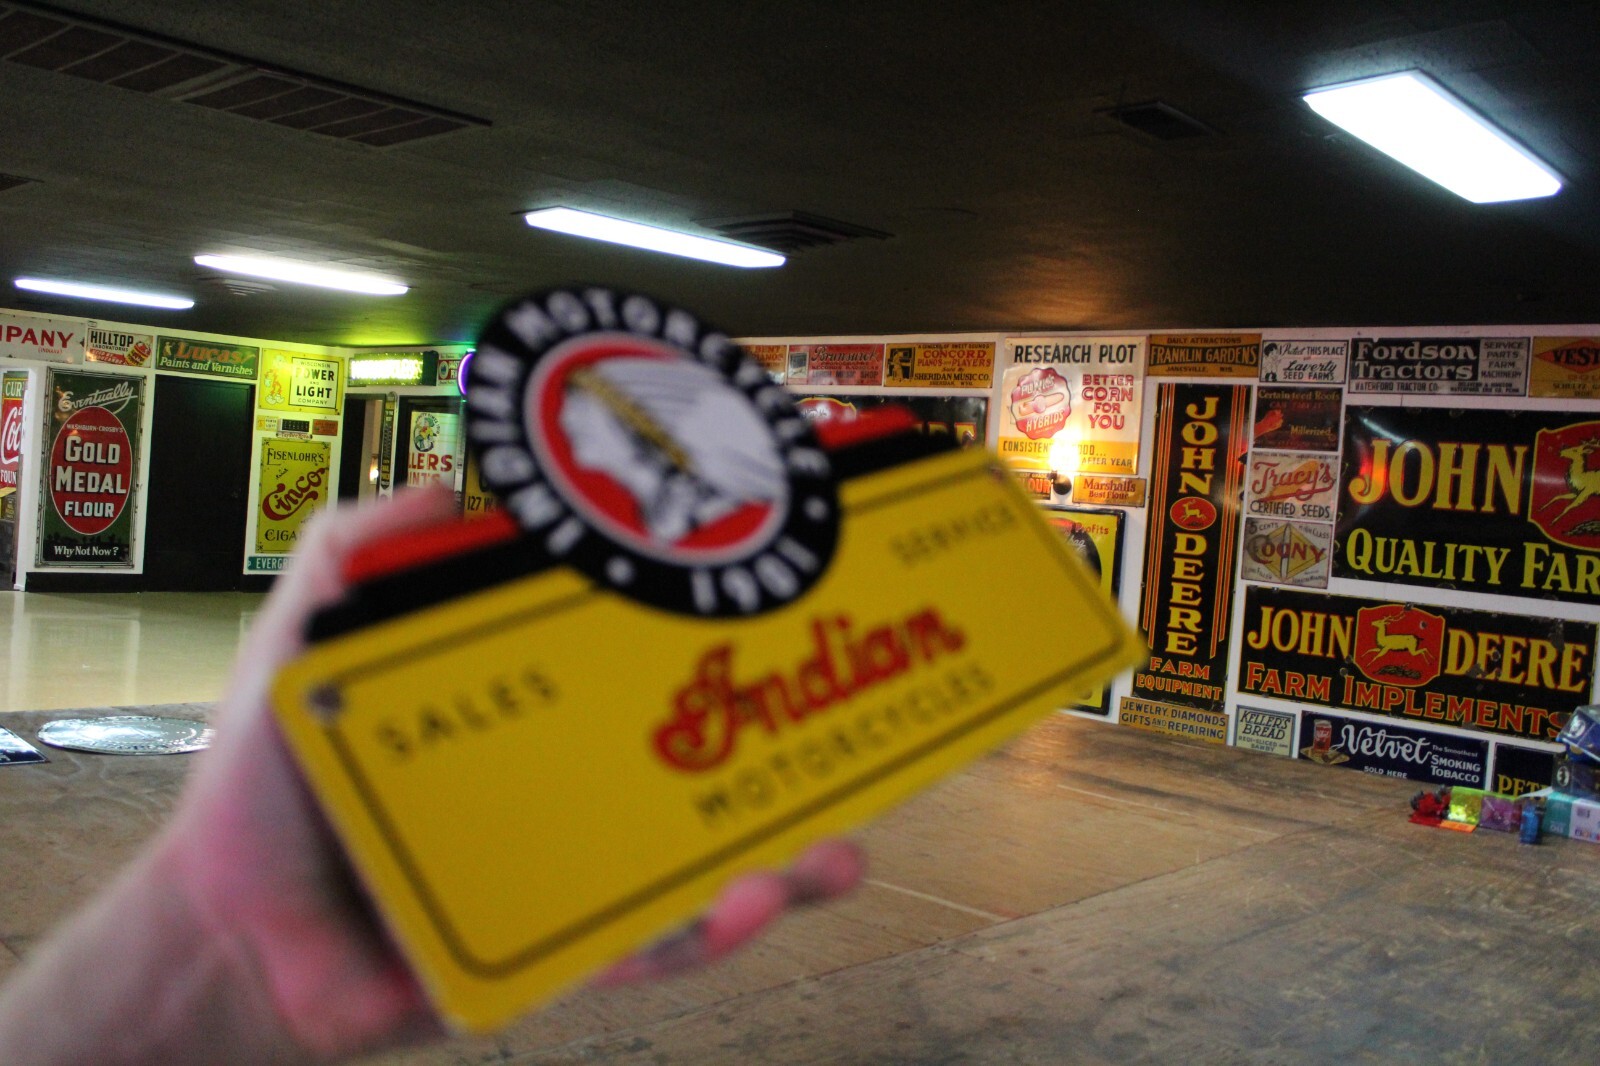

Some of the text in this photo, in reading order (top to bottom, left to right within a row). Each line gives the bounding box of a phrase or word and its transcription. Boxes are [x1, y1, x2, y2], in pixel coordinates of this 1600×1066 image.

[0, 324, 74, 349] PANY
[90, 330, 134, 347] HILLTOP
[1484, 341, 1524, 349] SERVICE
[175, 341, 243, 364] Lucas
[811, 346, 880, 362] Brunswick
[923, 350, 987, 358] CONCORD
[1014, 344, 1137, 363] RESEARCH PLOT
[1150, 345, 1258, 365] FRANKLIN GARDENS
[1307, 346, 1322, 355] THIS
[1356, 341, 1477, 360] Fordson
[1486, 351, 1519, 359] PARTS
[160, 356, 253, 375] Paints and Varnishes
[917, 358, 942, 366] PIANOS
[952, 359, 992, 367] PLAYERS
[1354, 360, 1473, 379] Tractors
[1488, 361, 1516, 369] FARM
[295, 367, 335, 381] POWER
[861, 370, 879, 378] SHOP
[914, 372, 951, 381] SHERIDAN
[953, 373, 977, 381] MUSIC
[1082, 374, 1134, 386] BETTER
[1283, 371, 1334, 380] SEED FARMS
[1481, 370, 1522, 379] MACHINERY
[5, 381, 24, 396] CUR
[296, 385, 332, 399] LIGHT
[1081, 387, 1134, 402] CORN
[1355, 381, 1394, 391] WATERFORD
[1396, 382, 1427, 391] TRACTOR
[58, 381, 138, 414] Eventually
[1314, 390, 1339, 400] Roofs
[1093, 402, 1121, 413] FOR
[1025, 410, 1065, 433] HYBRIDS
[1088, 414, 1125, 430] YOU
[64, 435, 120, 465] GOLD
[1178, 397, 1220, 495] JOHN
[267, 448, 324, 465] EISENLOHR'S
[408, 453, 453, 472] LERS
[1082, 457, 1133, 467] AFTER YEAR
[0, 469, 17, 484] FOUN
[55, 465, 127, 494] MEDAL
[1251, 460, 1336, 501] Tracy's
[1348, 438, 1530, 515] JOHN
[262, 467, 327, 521] Cinco
[1083, 479, 1136, 492] Marshall's
[467, 496, 481, 511] 127
[1107, 491, 1129, 500] Flour
[64, 501, 115, 518] FLOUR
[1250, 500, 1331, 518] CERTIFIED SEEDS
[1249, 521, 1279, 534] 5 CENTS
[54, 545, 74, 558] Why
[75, 546, 90, 556] Not
[1346, 527, 1511, 584] QUALITY
[1165, 532, 1207, 656] DEERE
[1247, 605, 1590, 693] JOHN DEERE
[1150, 656, 1210, 681] FARM
[651, 607, 966, 775] Indian
[1136, 673, 1222, 701] EQUIPMENT
[1246, 661, 1574, 739] FARM IMPLEMENTS
[375, 665, 558, 762] SALES
[1171, 709, 1226, 727] DIAMONDS
[1240, 710, 1291, 730] KELLER'S
[1121, 713, 1151, 726] GIFTS
[1152, 718, 1167, 727] AND
[1168, 721, 1224, 739] REPAIRING
[1242, 723, 1286, 740] BREAD
[1332, 724, 1432, 764] Velvet
[1431, 754, 1481, 772] SMOKING
[1364, 765, 1408, 779] SOLD HERE
[1431, 765, 1480, 783] TOBACCO
